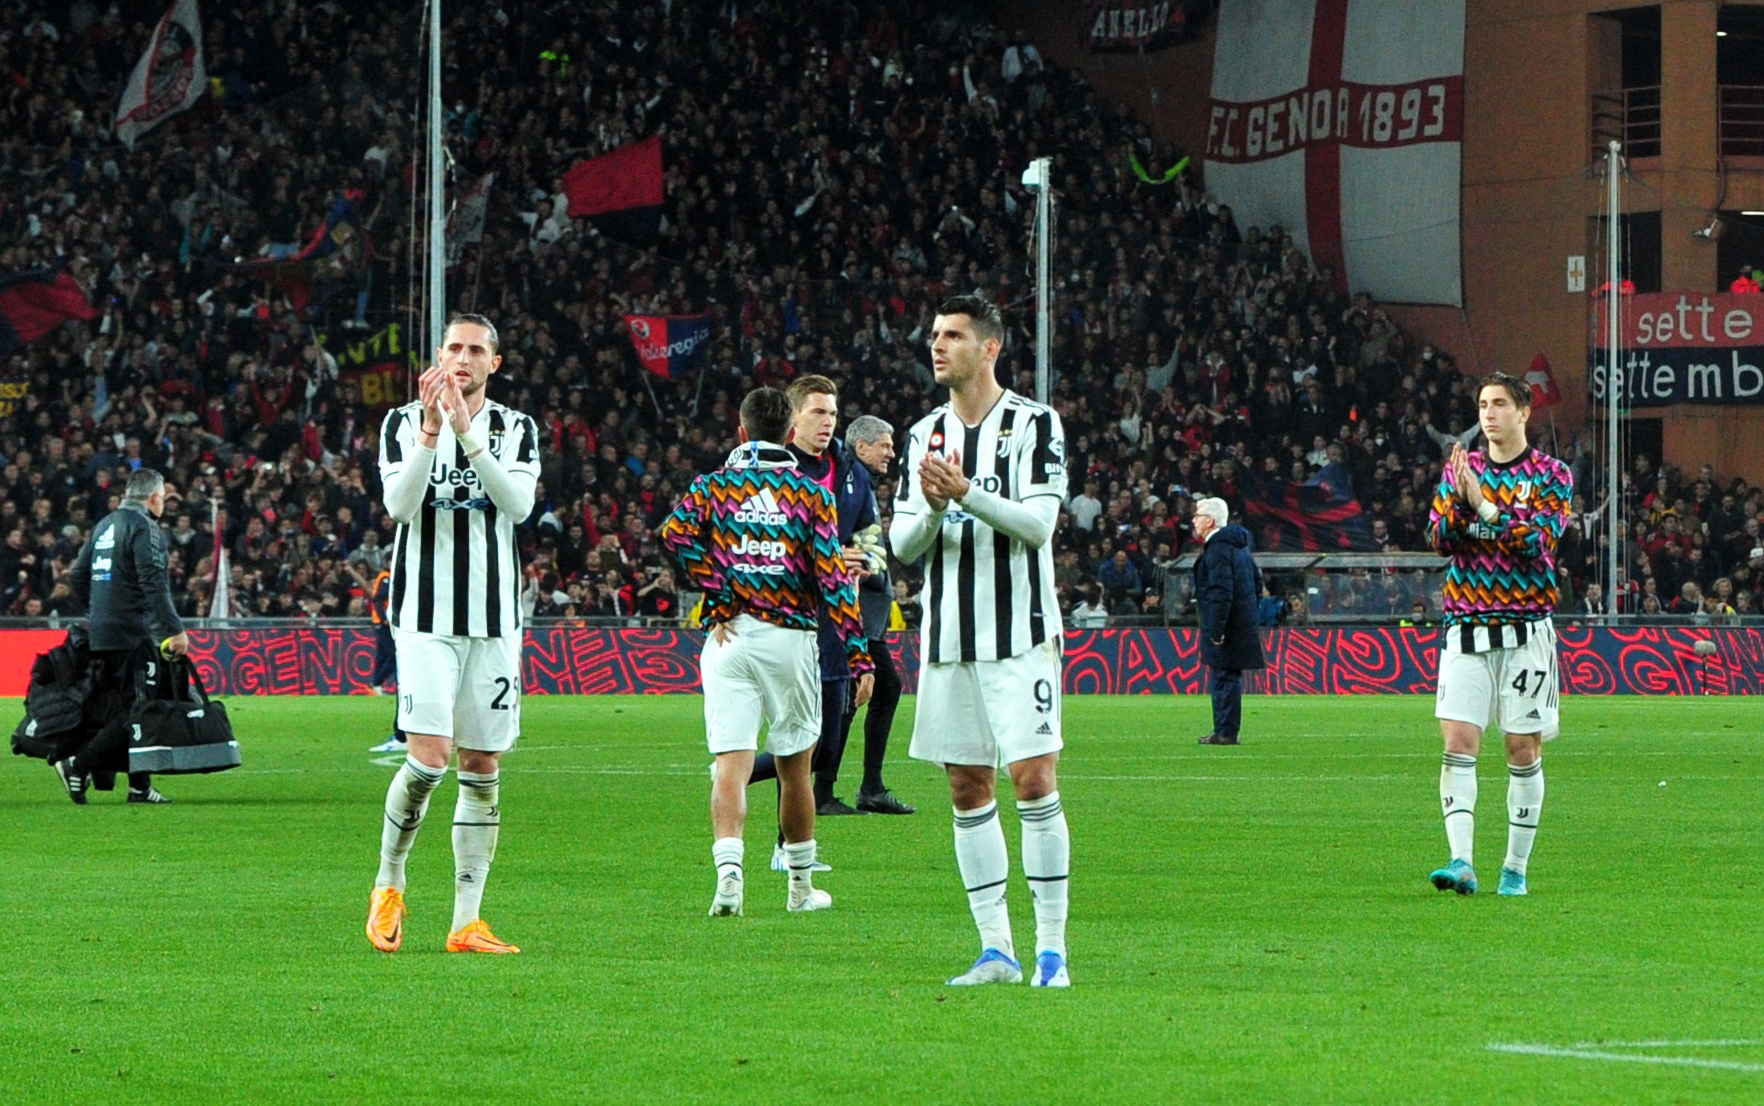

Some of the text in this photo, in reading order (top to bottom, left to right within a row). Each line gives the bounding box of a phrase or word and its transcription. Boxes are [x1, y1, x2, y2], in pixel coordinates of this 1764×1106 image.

[1090, 0, 1170, 38] ANELLO
[1245, 87, 1350, 157] GENOA
[1359, 85, 1447, 143] 1893
[1636, 295, 1753, 345] sette
[734, 509, 788, 526] adidas
[731, 534, 787, 561] Jeep
[1034, 678, 1053, 714] 9
[1512, 670, 1546, 697] 47
